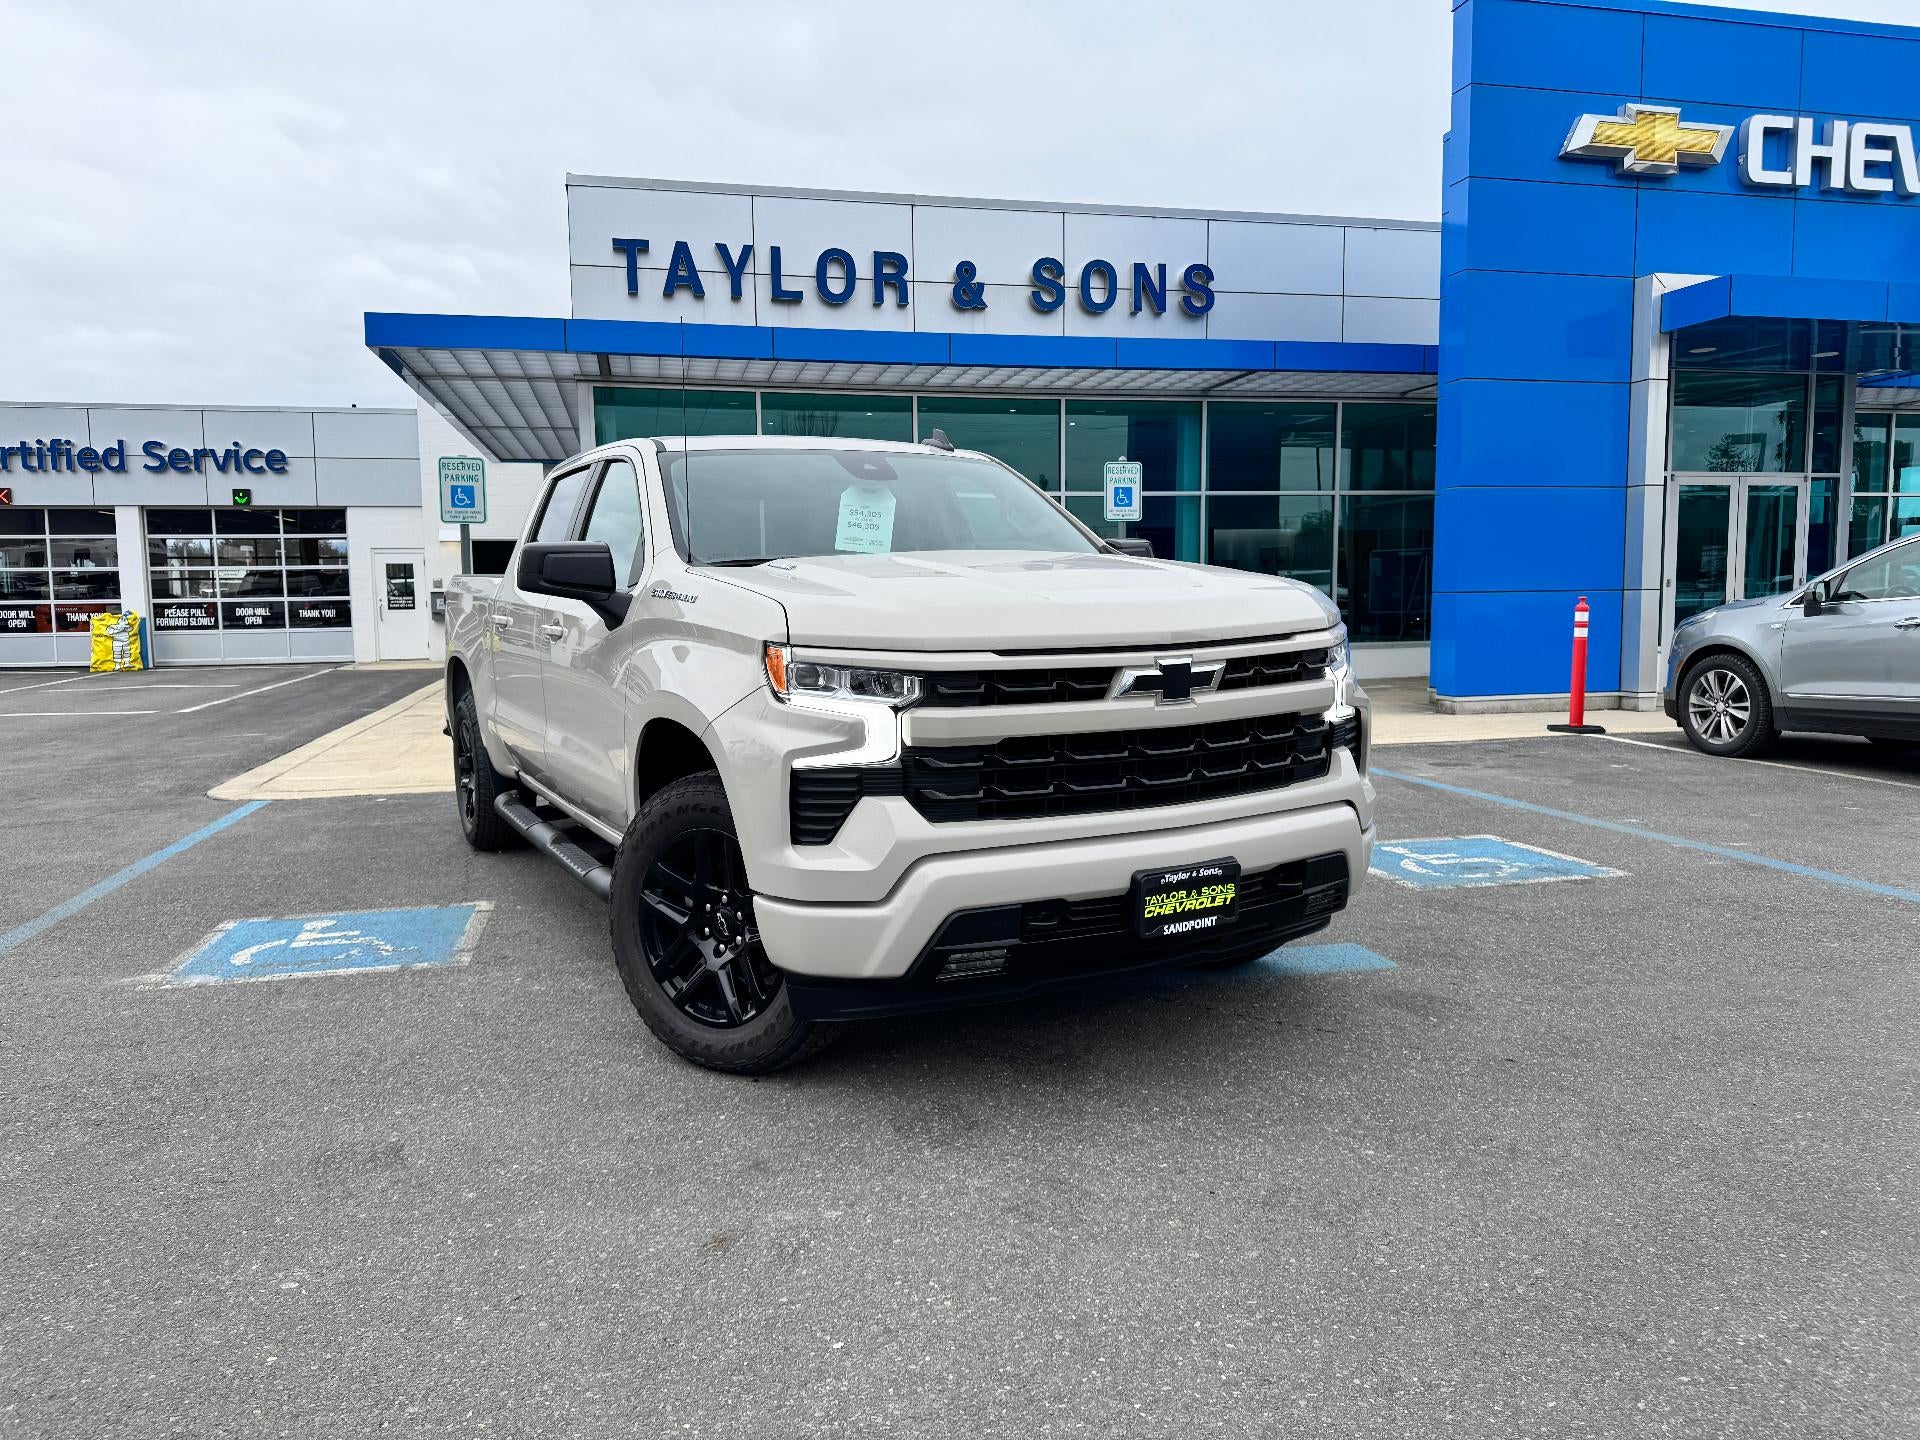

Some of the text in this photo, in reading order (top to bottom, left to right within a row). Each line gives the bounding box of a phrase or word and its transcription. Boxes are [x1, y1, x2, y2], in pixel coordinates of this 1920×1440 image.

[611, 237, 1216, 316] TAYLOR & SONS
[0, 438, 289, 474] rtified Service
[442, 462, 480, 471] RESERVED
[1108, 466, 1138, 474] RESERVED
[444, 473, 479, 482] PARKING
[18, 610, 36, 619] WILL
[164, 608, 207, 617] PLEASE PULL
[235, 608, 271, 616] DOOR WILL
[299, 609, 336, 618] THANK YOU!
[66, 612, 89, 622] THANK
[244, 616, 262, 625] OPEN
[8, 619, 27, 628] OPEN
[156, 617, 215, 627] FORWARD SLOWLY
[1164, 867, 1219, 884] Taylor & Sons
[1144, 883, 1235, 906] TAYLOR & SONS
[1144, 893, 1236, 918] CHEVROLET
[1163, 916, 1217, 935] SANDPOINT
